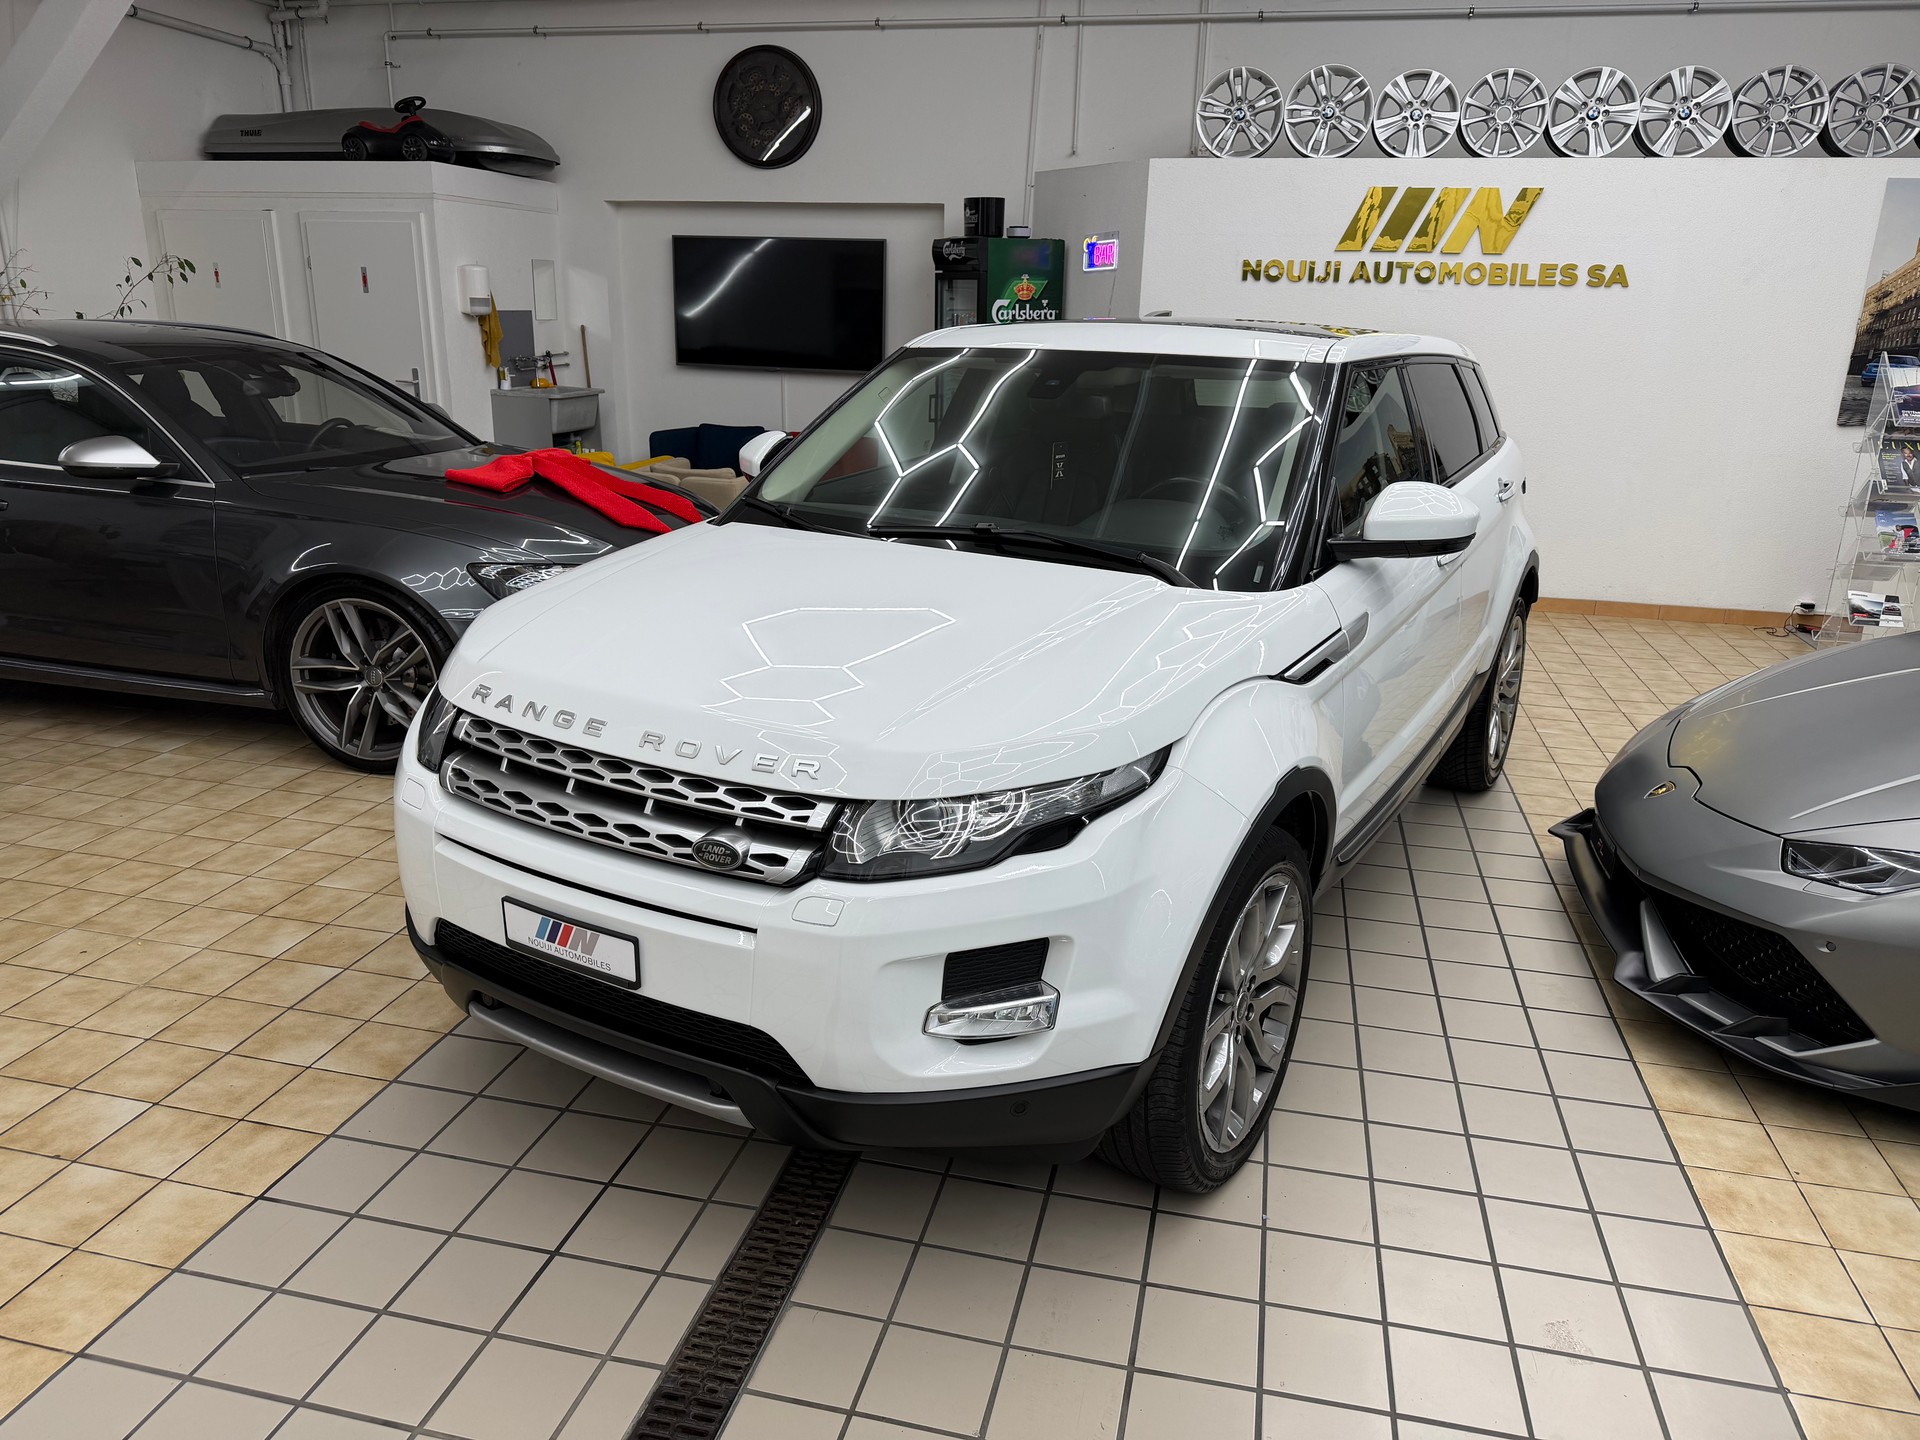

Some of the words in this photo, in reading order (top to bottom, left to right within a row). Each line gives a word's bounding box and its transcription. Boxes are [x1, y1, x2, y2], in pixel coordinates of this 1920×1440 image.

[240, 129, 262, 137] THULE
[1094, 243, 1115, 266] BAR
[1348, 260, 1579, 287] AUTOMOBILES
[1586, 263, 1630, 288] SA
[471, 683, 608, 737] RANGE
[638, 729, 822, 780] ROVER
[702, 843, 726, 855] LAND
[703, 852, 732, 865] ROVER
[527, 936, 553, 952] NOUIJI
[554, 946, 612, 972] AUTOMOBILES
